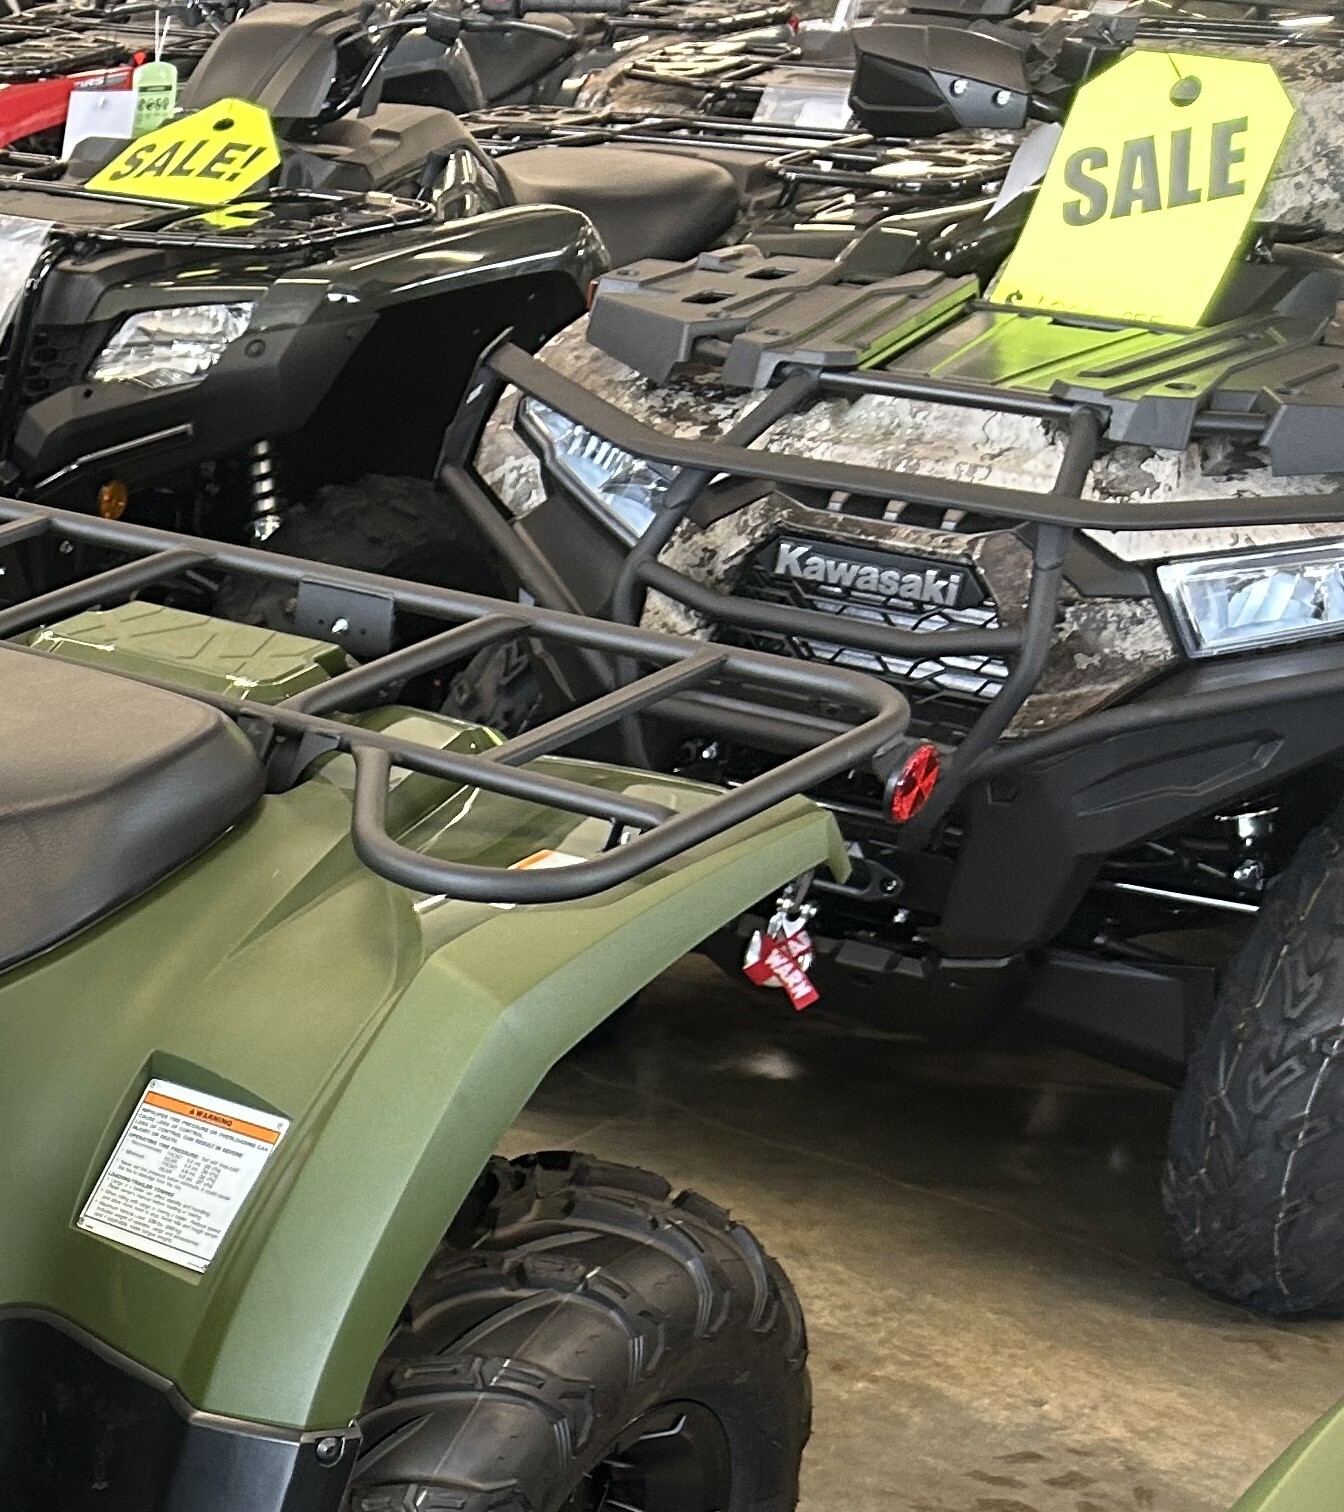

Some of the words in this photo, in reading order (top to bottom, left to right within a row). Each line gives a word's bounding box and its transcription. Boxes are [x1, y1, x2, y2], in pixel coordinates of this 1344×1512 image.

[109, 139, 268, 182] SALE!
[1063, 116, 1248, 226] SALE
[774, 543, 964, 607] Kawasaki
[765, 947, 812, 1000] WARN
